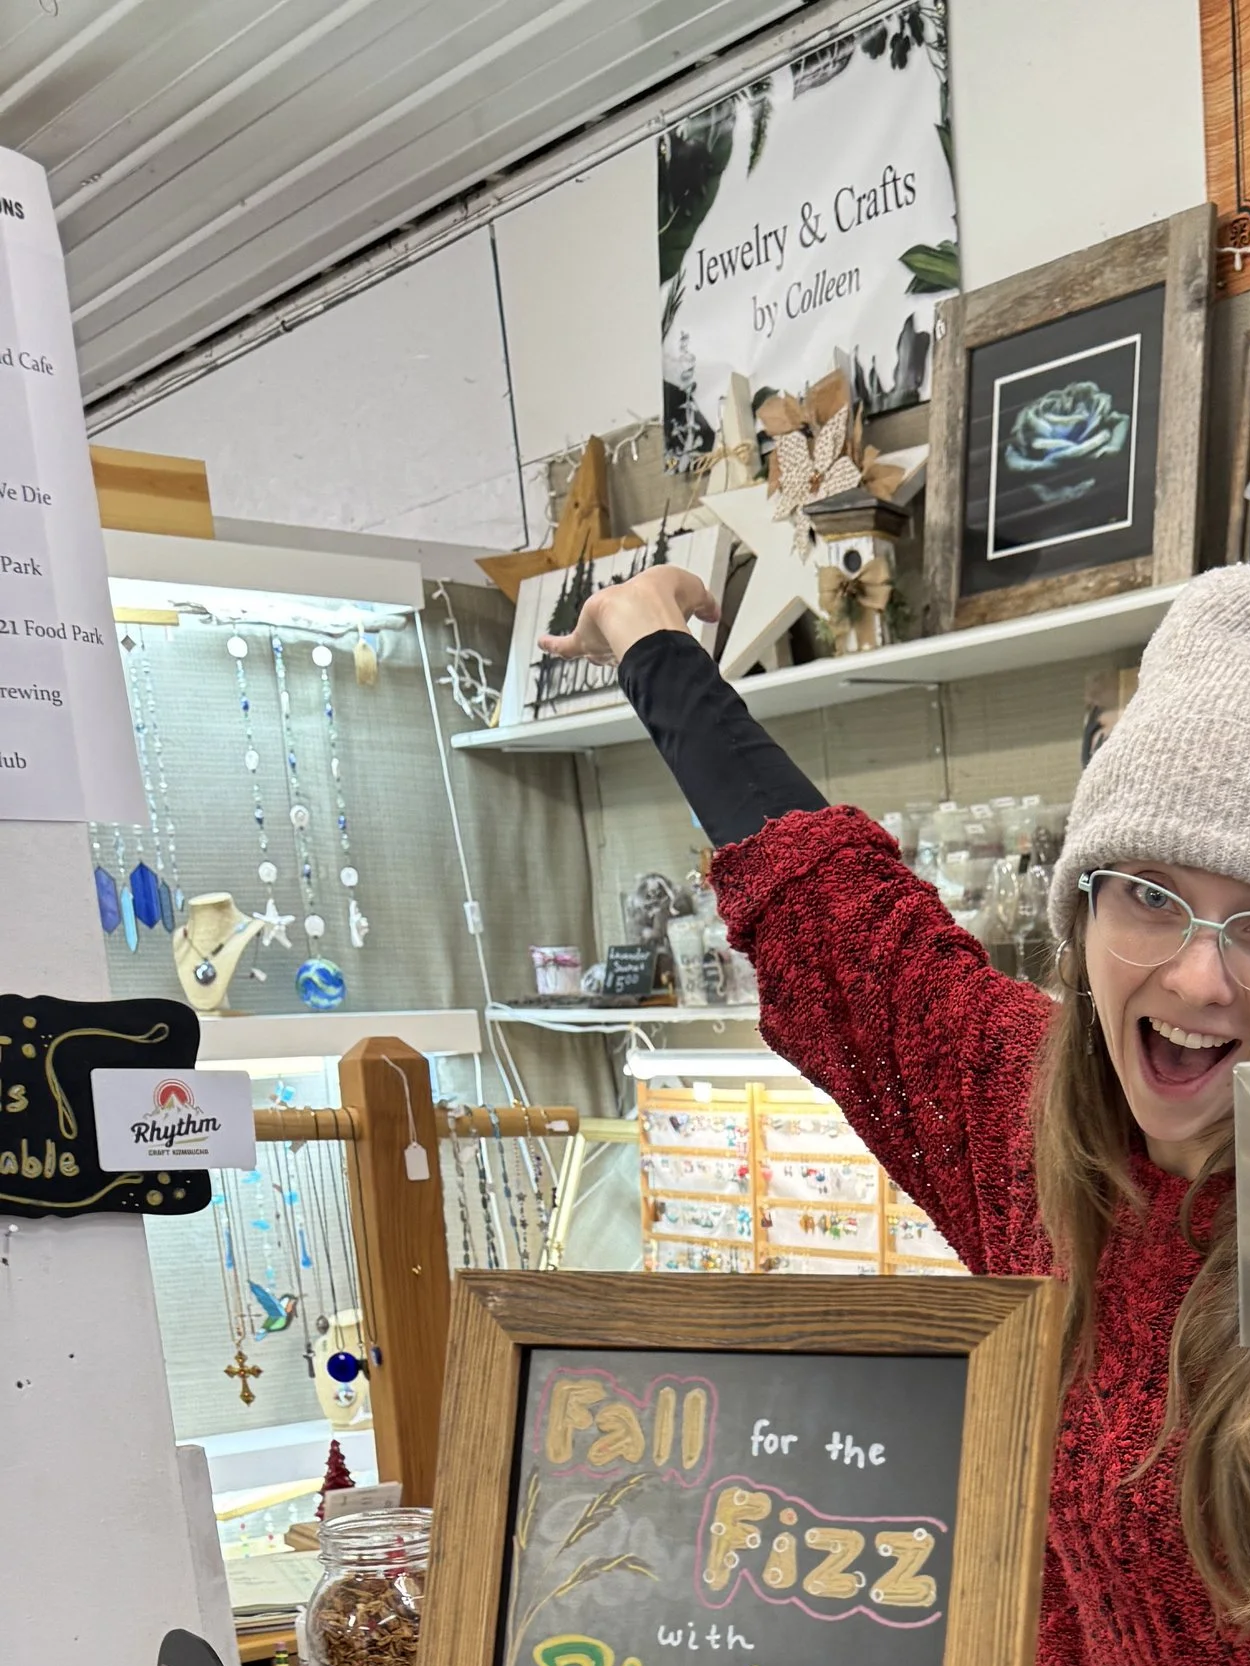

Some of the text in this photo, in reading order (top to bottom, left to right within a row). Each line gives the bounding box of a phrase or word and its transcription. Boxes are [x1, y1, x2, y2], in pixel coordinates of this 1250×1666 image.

[694, 164, 916, 291] Jewelry & Crafts
[752, 267, 861, 338] by Colleen
[19, 351, 54, 377] Cafe
[22, 484, 52, 506] Die
[1, 555, 42, 577] Park
[24, 619, 67, 640] Food
[72, 623, 104, 646] Park
[0, 684, 63, 707] rewing
[130, 1113, 222, 1149] Rhythm
[546, 1377, 887, 1474] Fall for the
[703, 1485, 940, 1609] Fizz
[656, 1622, 756, 1652] with
